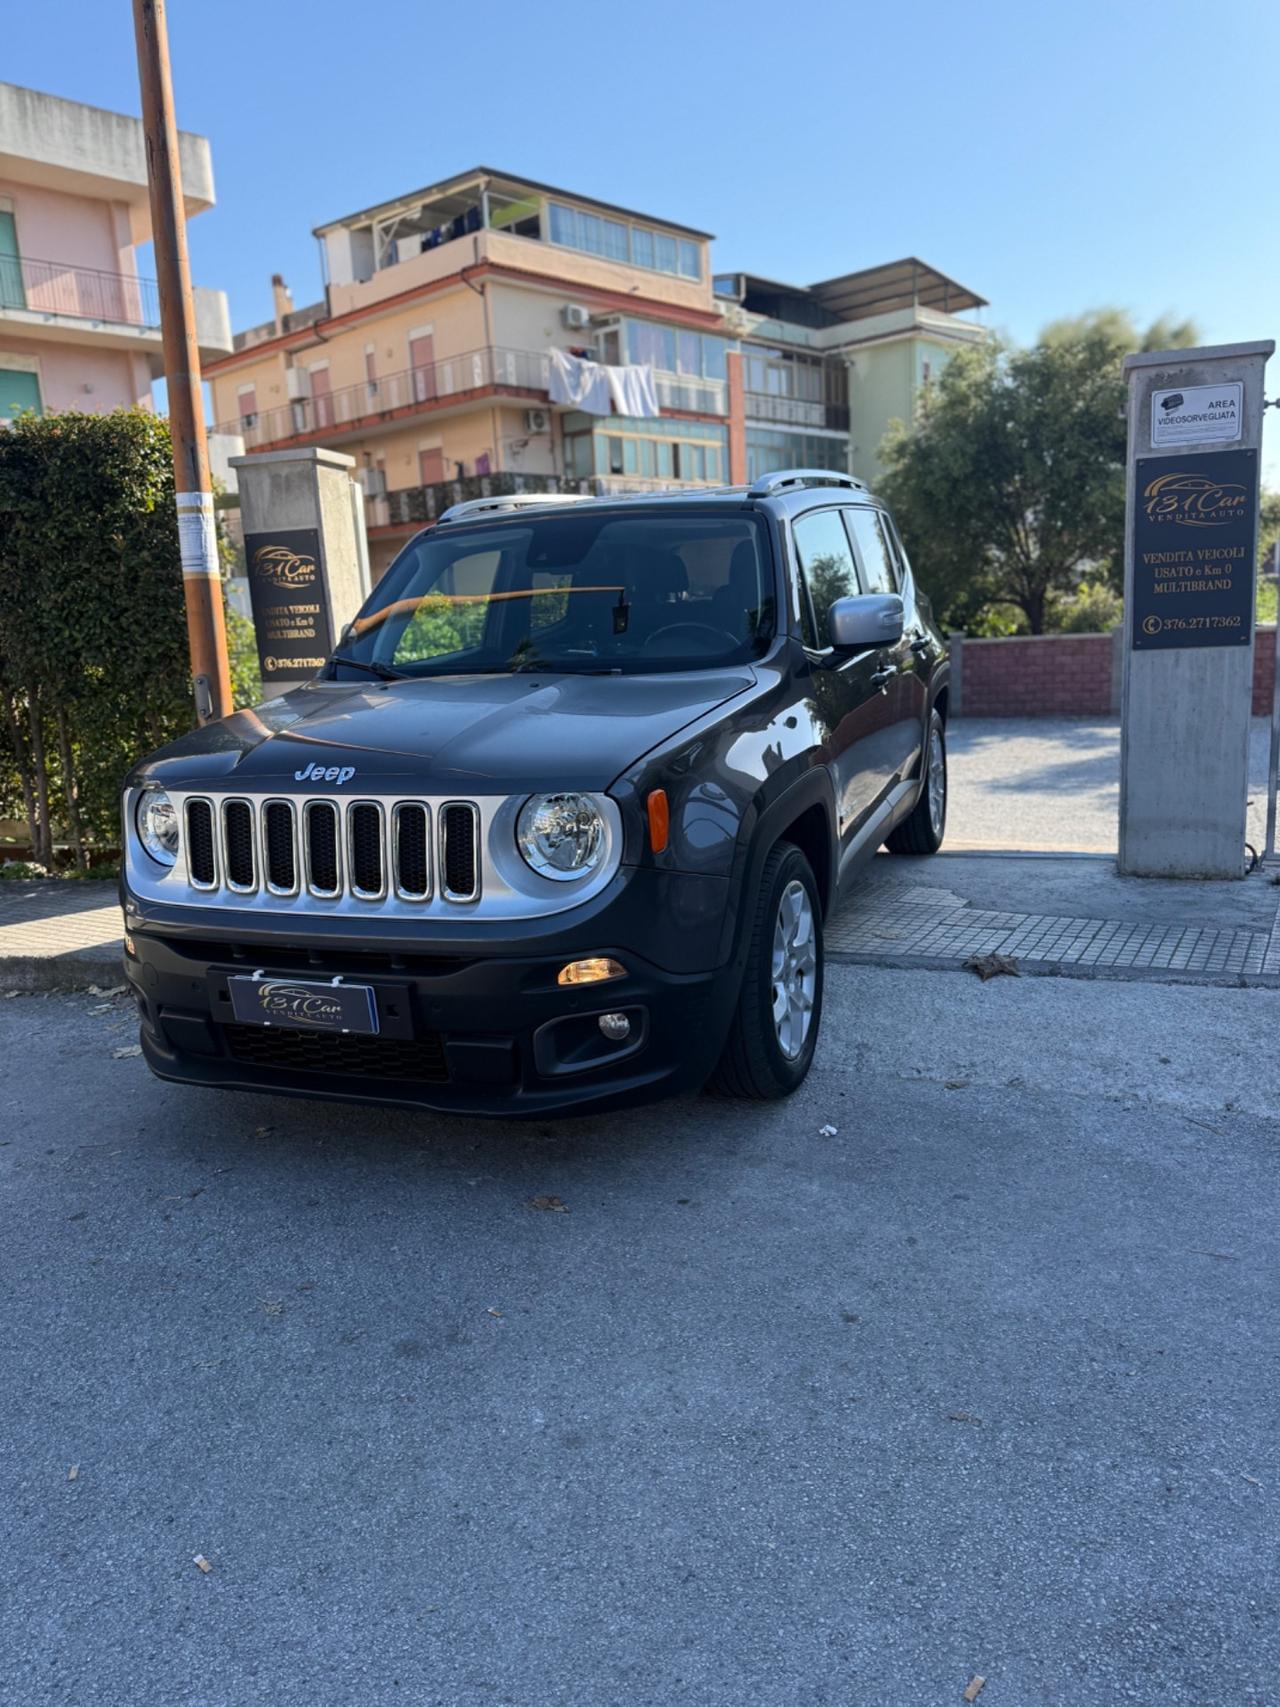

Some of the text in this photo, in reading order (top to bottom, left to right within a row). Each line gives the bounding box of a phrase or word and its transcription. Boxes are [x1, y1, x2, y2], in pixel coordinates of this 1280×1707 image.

[1208, 400, 1236, 409] AREA
[1158, 411, 1236, 425] VIDEOSORVEGLIATA
[1148, 509, 1245, 522] VENDITA AUTO
[1142, 547, 1245, 564] VENDITA VEICOLI
[1154, 566, 1193, 578] USATO
[1204, 564, 1222, 576] Km
[1153, 579, 1232, 594] MULTIBRAND
[1163, 616, 1241, 630] 376.2717362
[294, 762, 356, 785] Jeep
